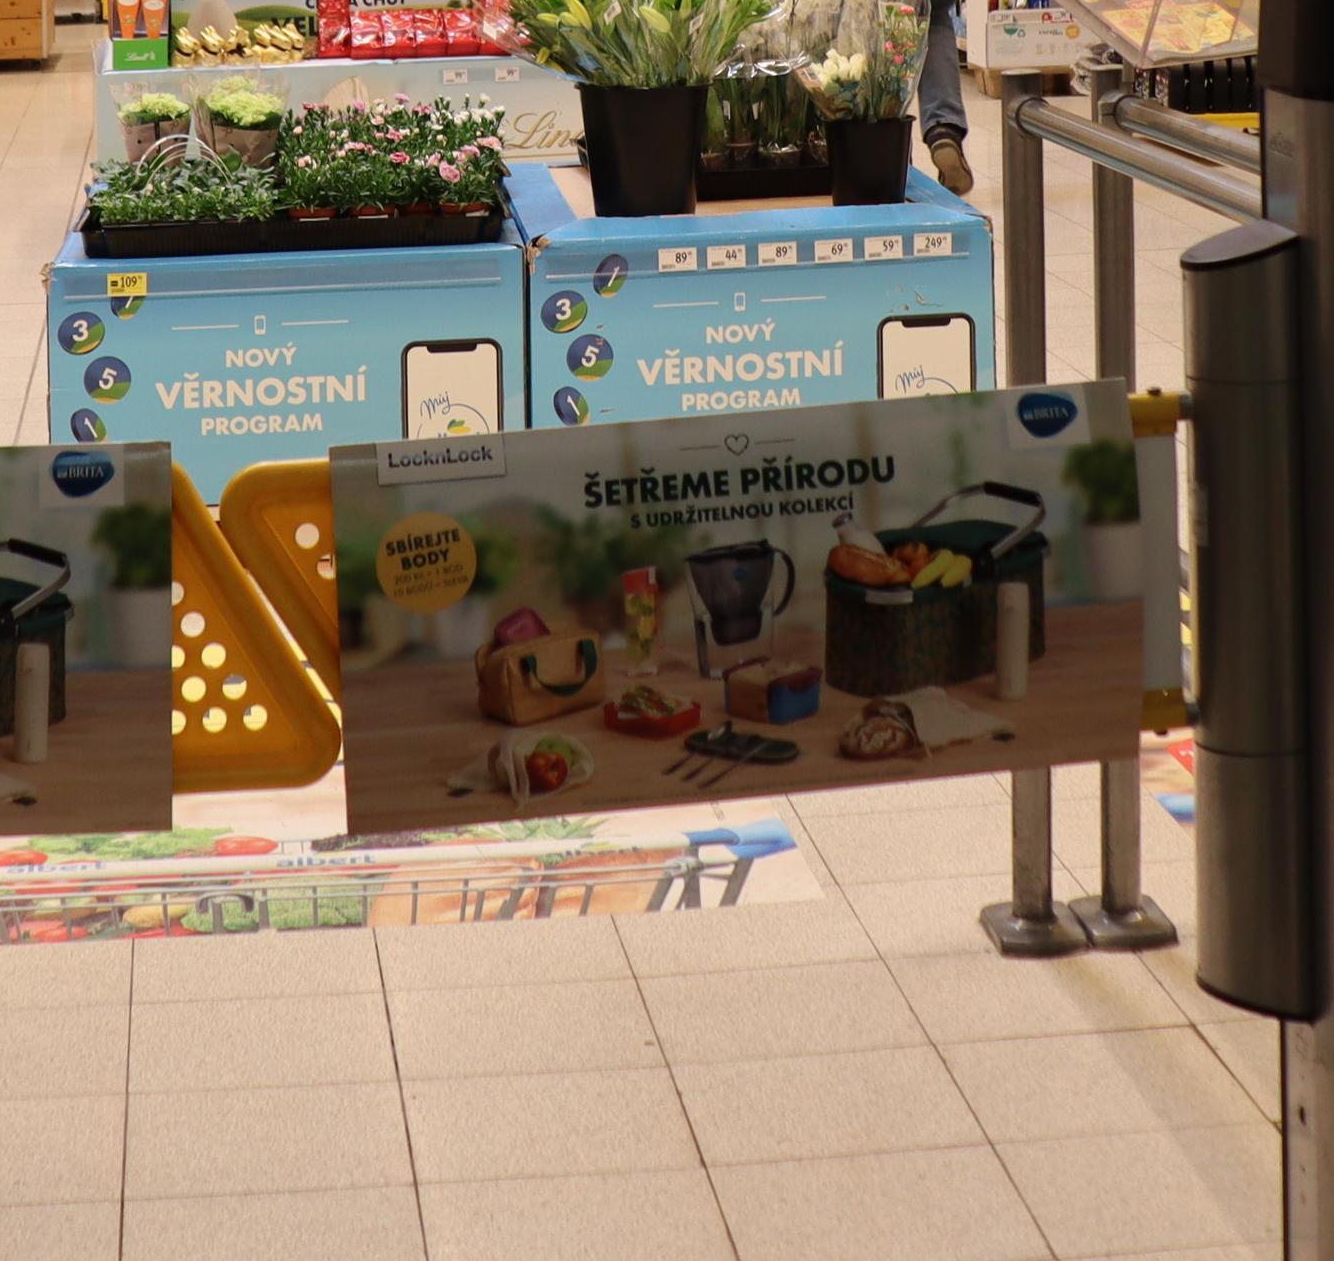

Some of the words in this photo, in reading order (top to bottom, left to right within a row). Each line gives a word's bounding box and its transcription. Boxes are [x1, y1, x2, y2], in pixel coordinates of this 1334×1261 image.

[556, 298, 571, 321] 3
[72, 319, 89, 342] 3
[706, 318, 775, 344] NOVÝ
[225, 342, 296, 368] NOVÝ
[581, 345, 599, 368] 5
[637, 340, 844, 386] VĚRNOSTNÍ
[98, 368, 117, 390] 5
[155, 364, 367, 410] VĚRNOSTNÍ
[682, 388, 801, 411] PROGRAM
[201, 414, 323, 436] PROGRAM
[388, 445, 493, 468] LocknLock
[69, 465, 105, 479] BRITA
[584, 466, 730, 509] ŠETŘEME
[740, 455, 895, 495] PŘÍRODU
[630, 513, 641, 529] S
[647, 502, 774, 529] UDRŽITELNOU
[778, 491, 854, 517] KOLEKCÍ
[386, 527, 461, 557] SBÍREJTE
[401, 548, 450, 571] BODY
[7, 859, 107, 875] albert
[276, 852, 377, 868] albert
